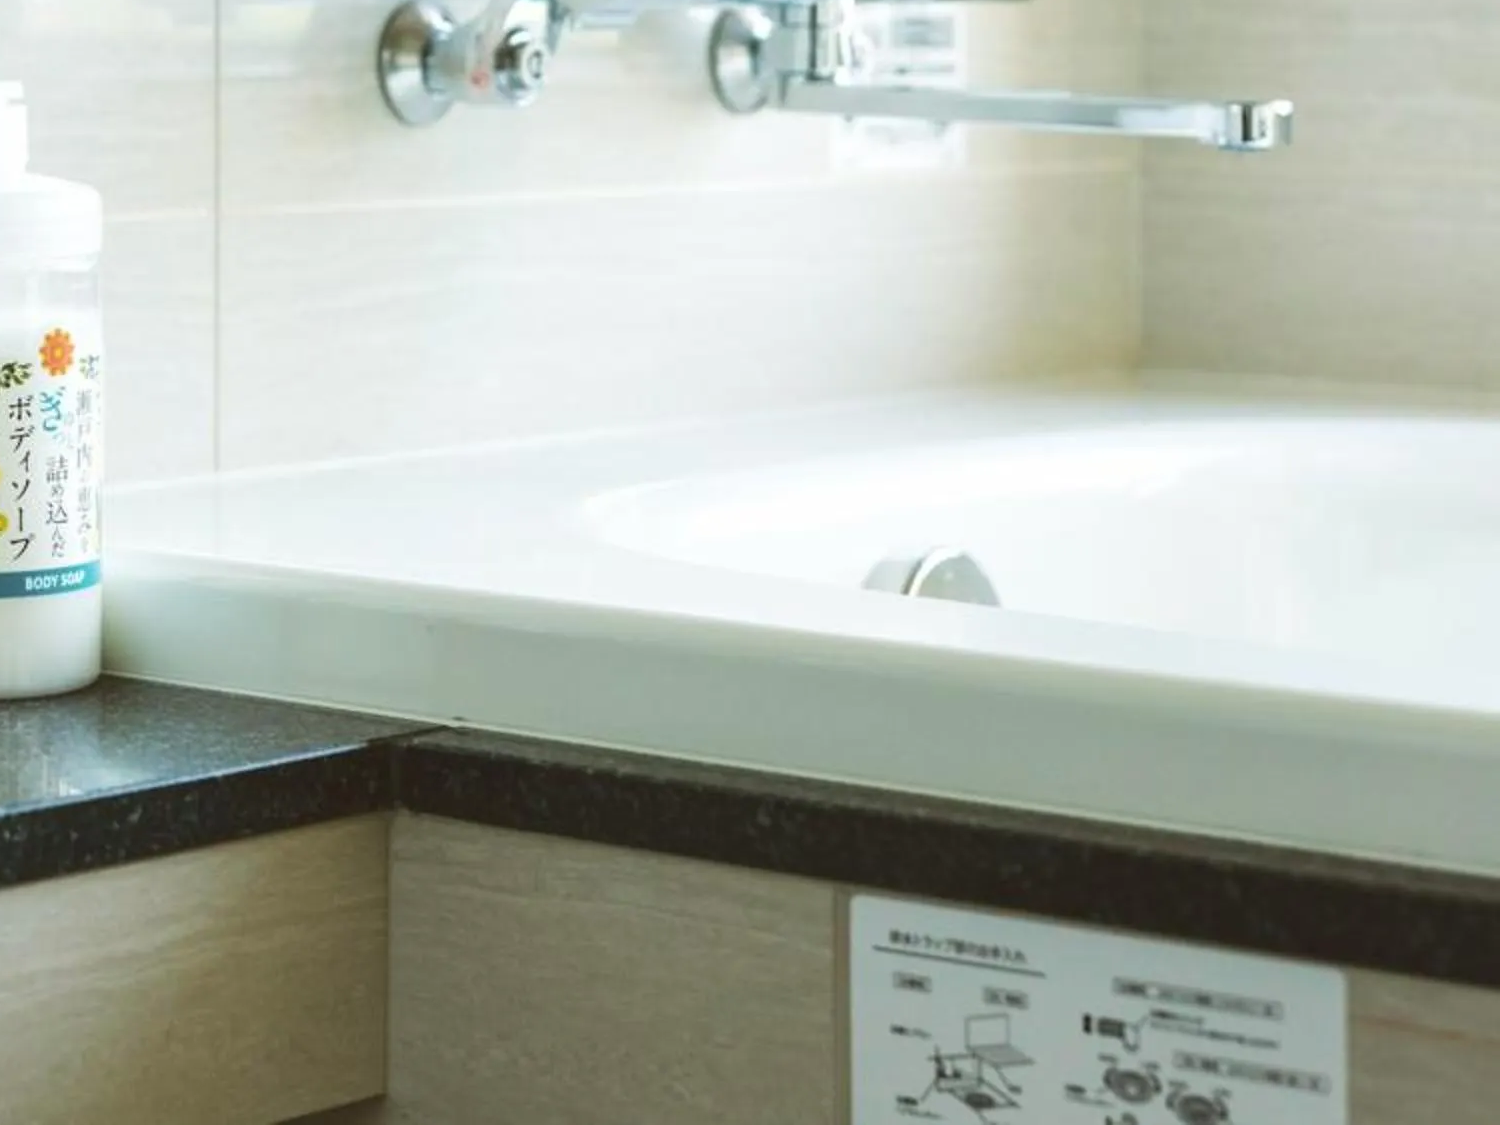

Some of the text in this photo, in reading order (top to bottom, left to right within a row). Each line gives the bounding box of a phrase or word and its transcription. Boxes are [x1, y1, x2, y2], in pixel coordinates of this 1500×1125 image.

[8, 394, 36, 562] ボディソープ
[25, 569, 85, 591] BODY SOAP
